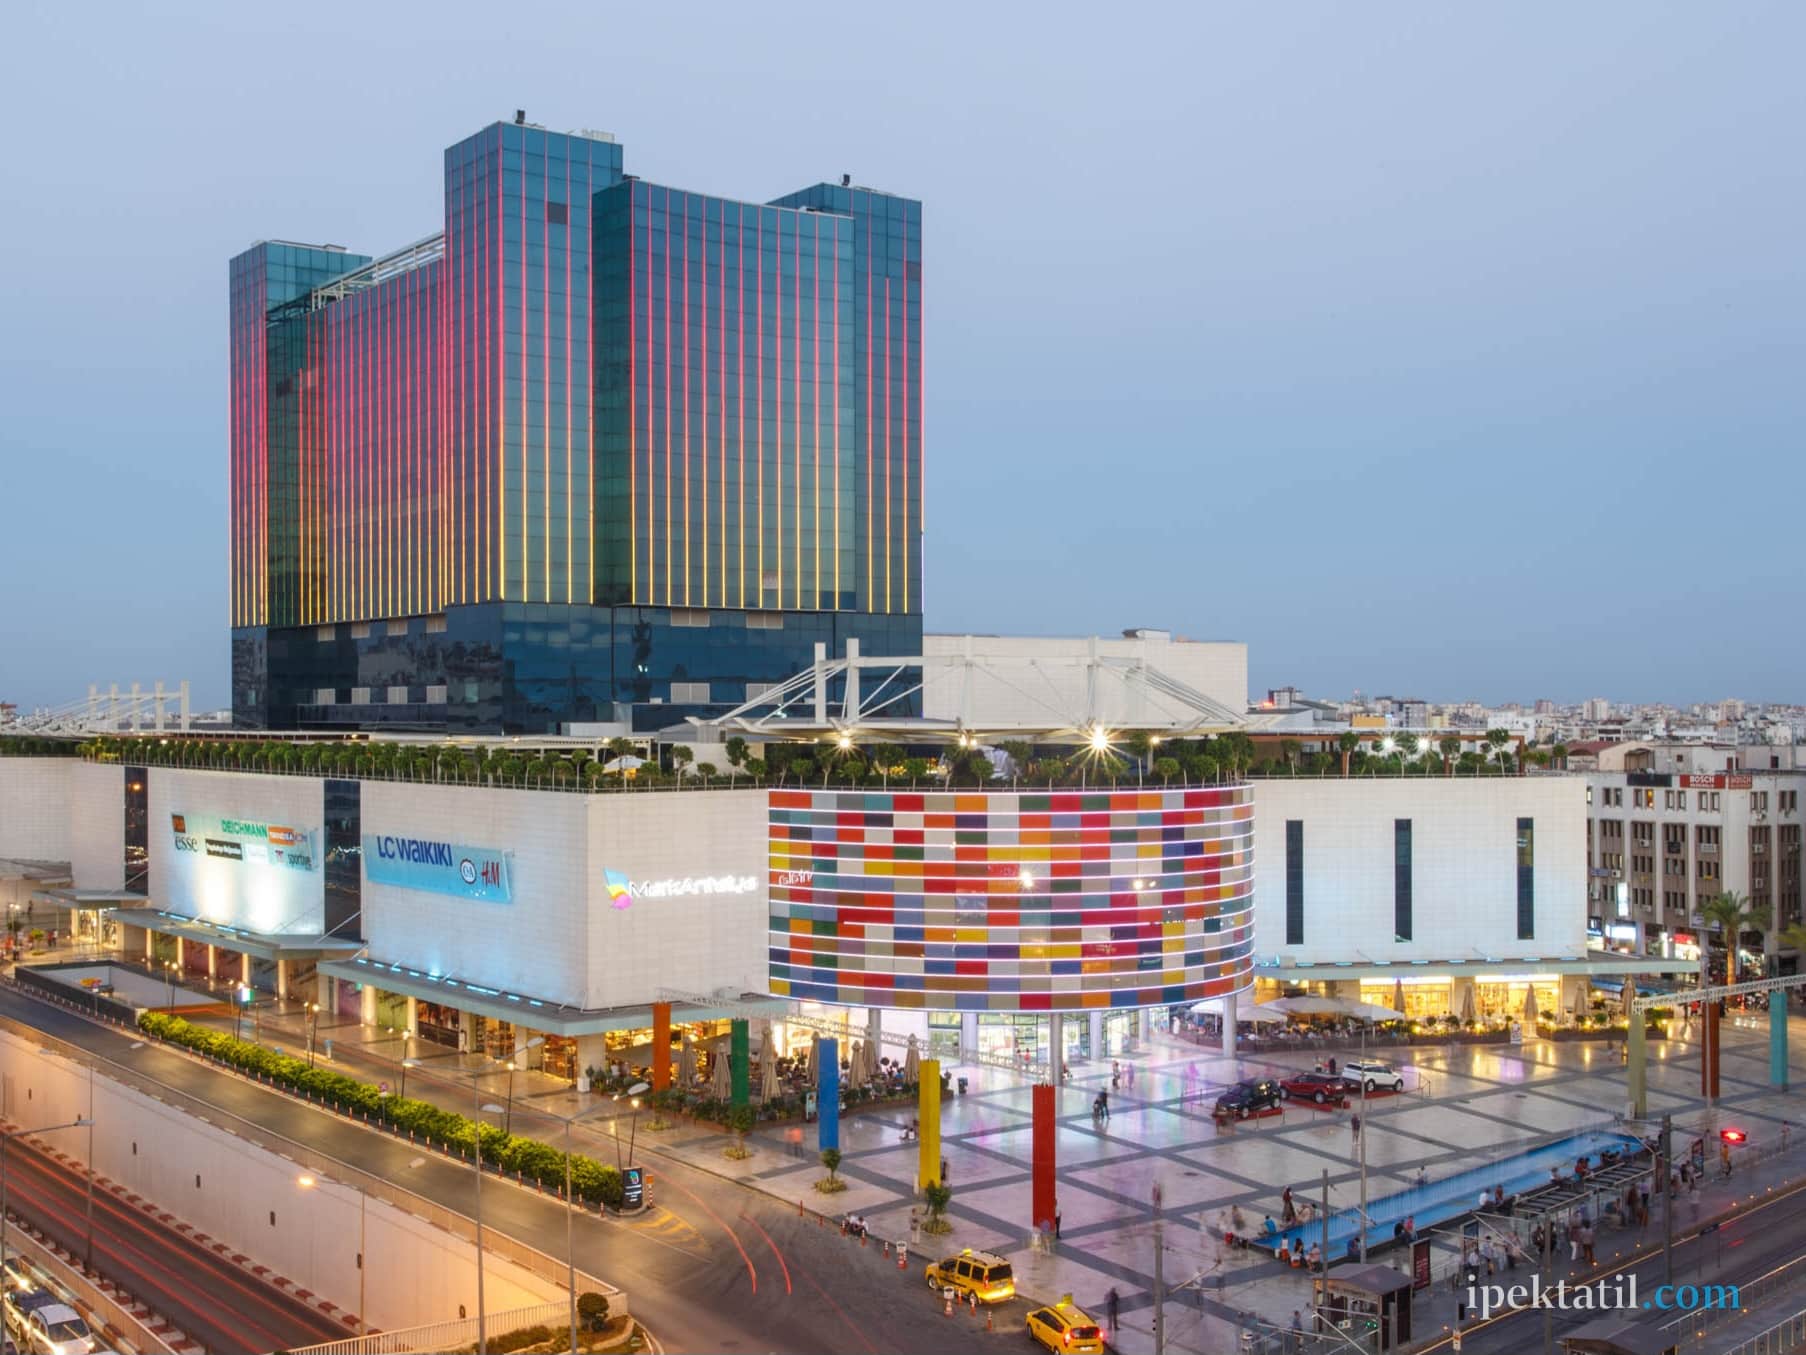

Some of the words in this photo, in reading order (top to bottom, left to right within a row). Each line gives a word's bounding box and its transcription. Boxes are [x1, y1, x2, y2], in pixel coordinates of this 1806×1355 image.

[1690, 775, 1714, 784] BOSCH
[221, 820, 267, 837] DEICHMANN
[175, 836, 199, 852] esse
[377, 836, 396, 859] LC
